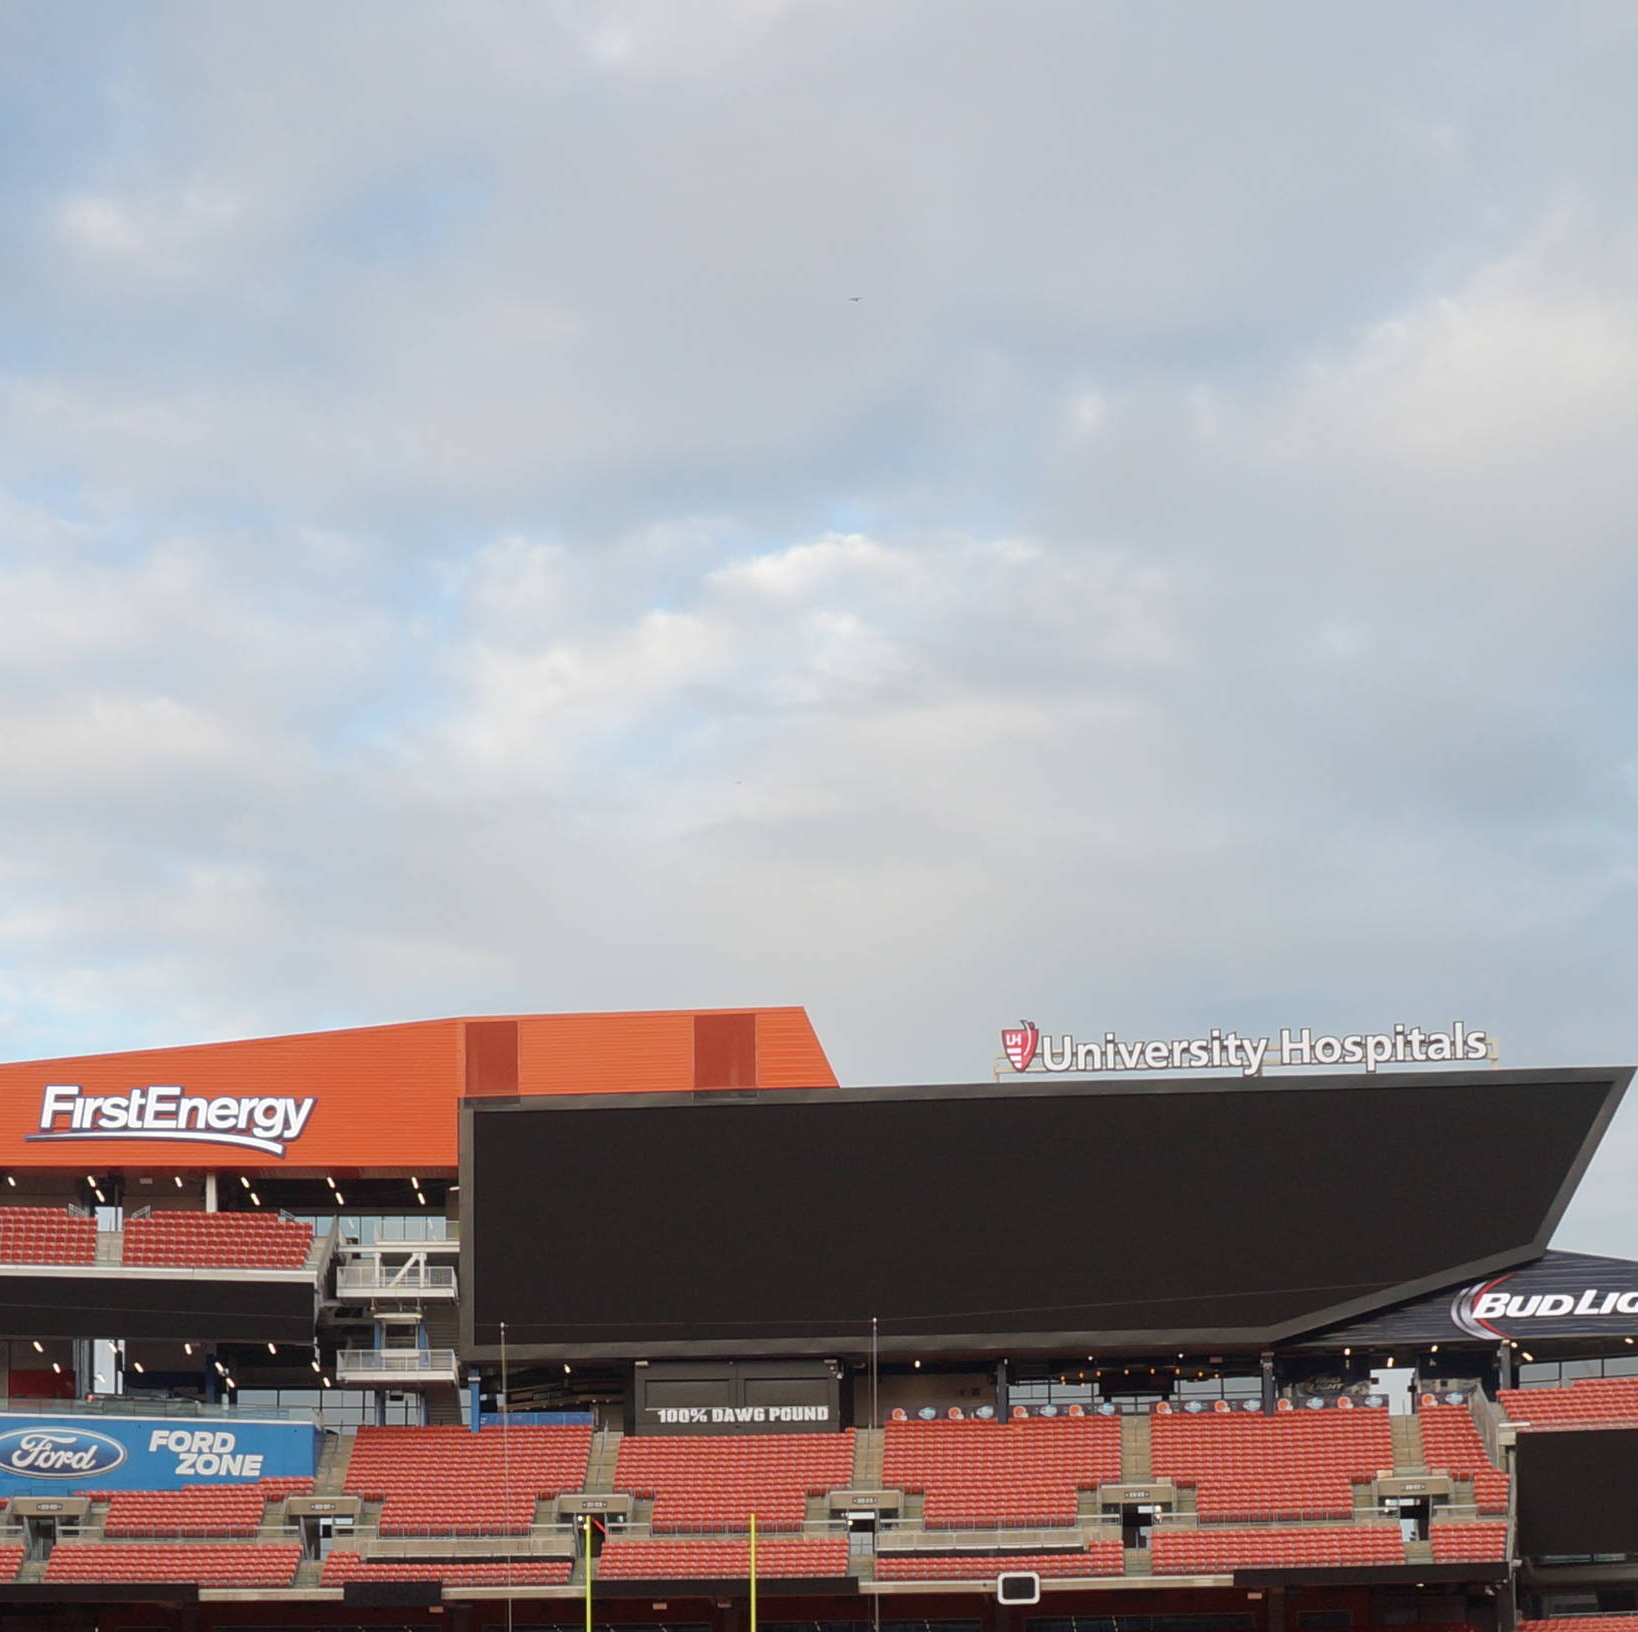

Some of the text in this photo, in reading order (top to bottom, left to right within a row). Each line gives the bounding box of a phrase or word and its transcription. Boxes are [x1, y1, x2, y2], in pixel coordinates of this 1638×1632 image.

[1042, 1021, 1488, 1076] University Hospitals
[39, 1085, 315, 1139] FirstEnergy
[1472, 1292, 1575, 1319] BUD
[657, 1406, 829, 1423] 100% DAWG POUND
[12, 1434, 98, 1470] Ford
[148, 1430, 235, 1453] FORD
[175, 1453, 263, 1476] ZONE
